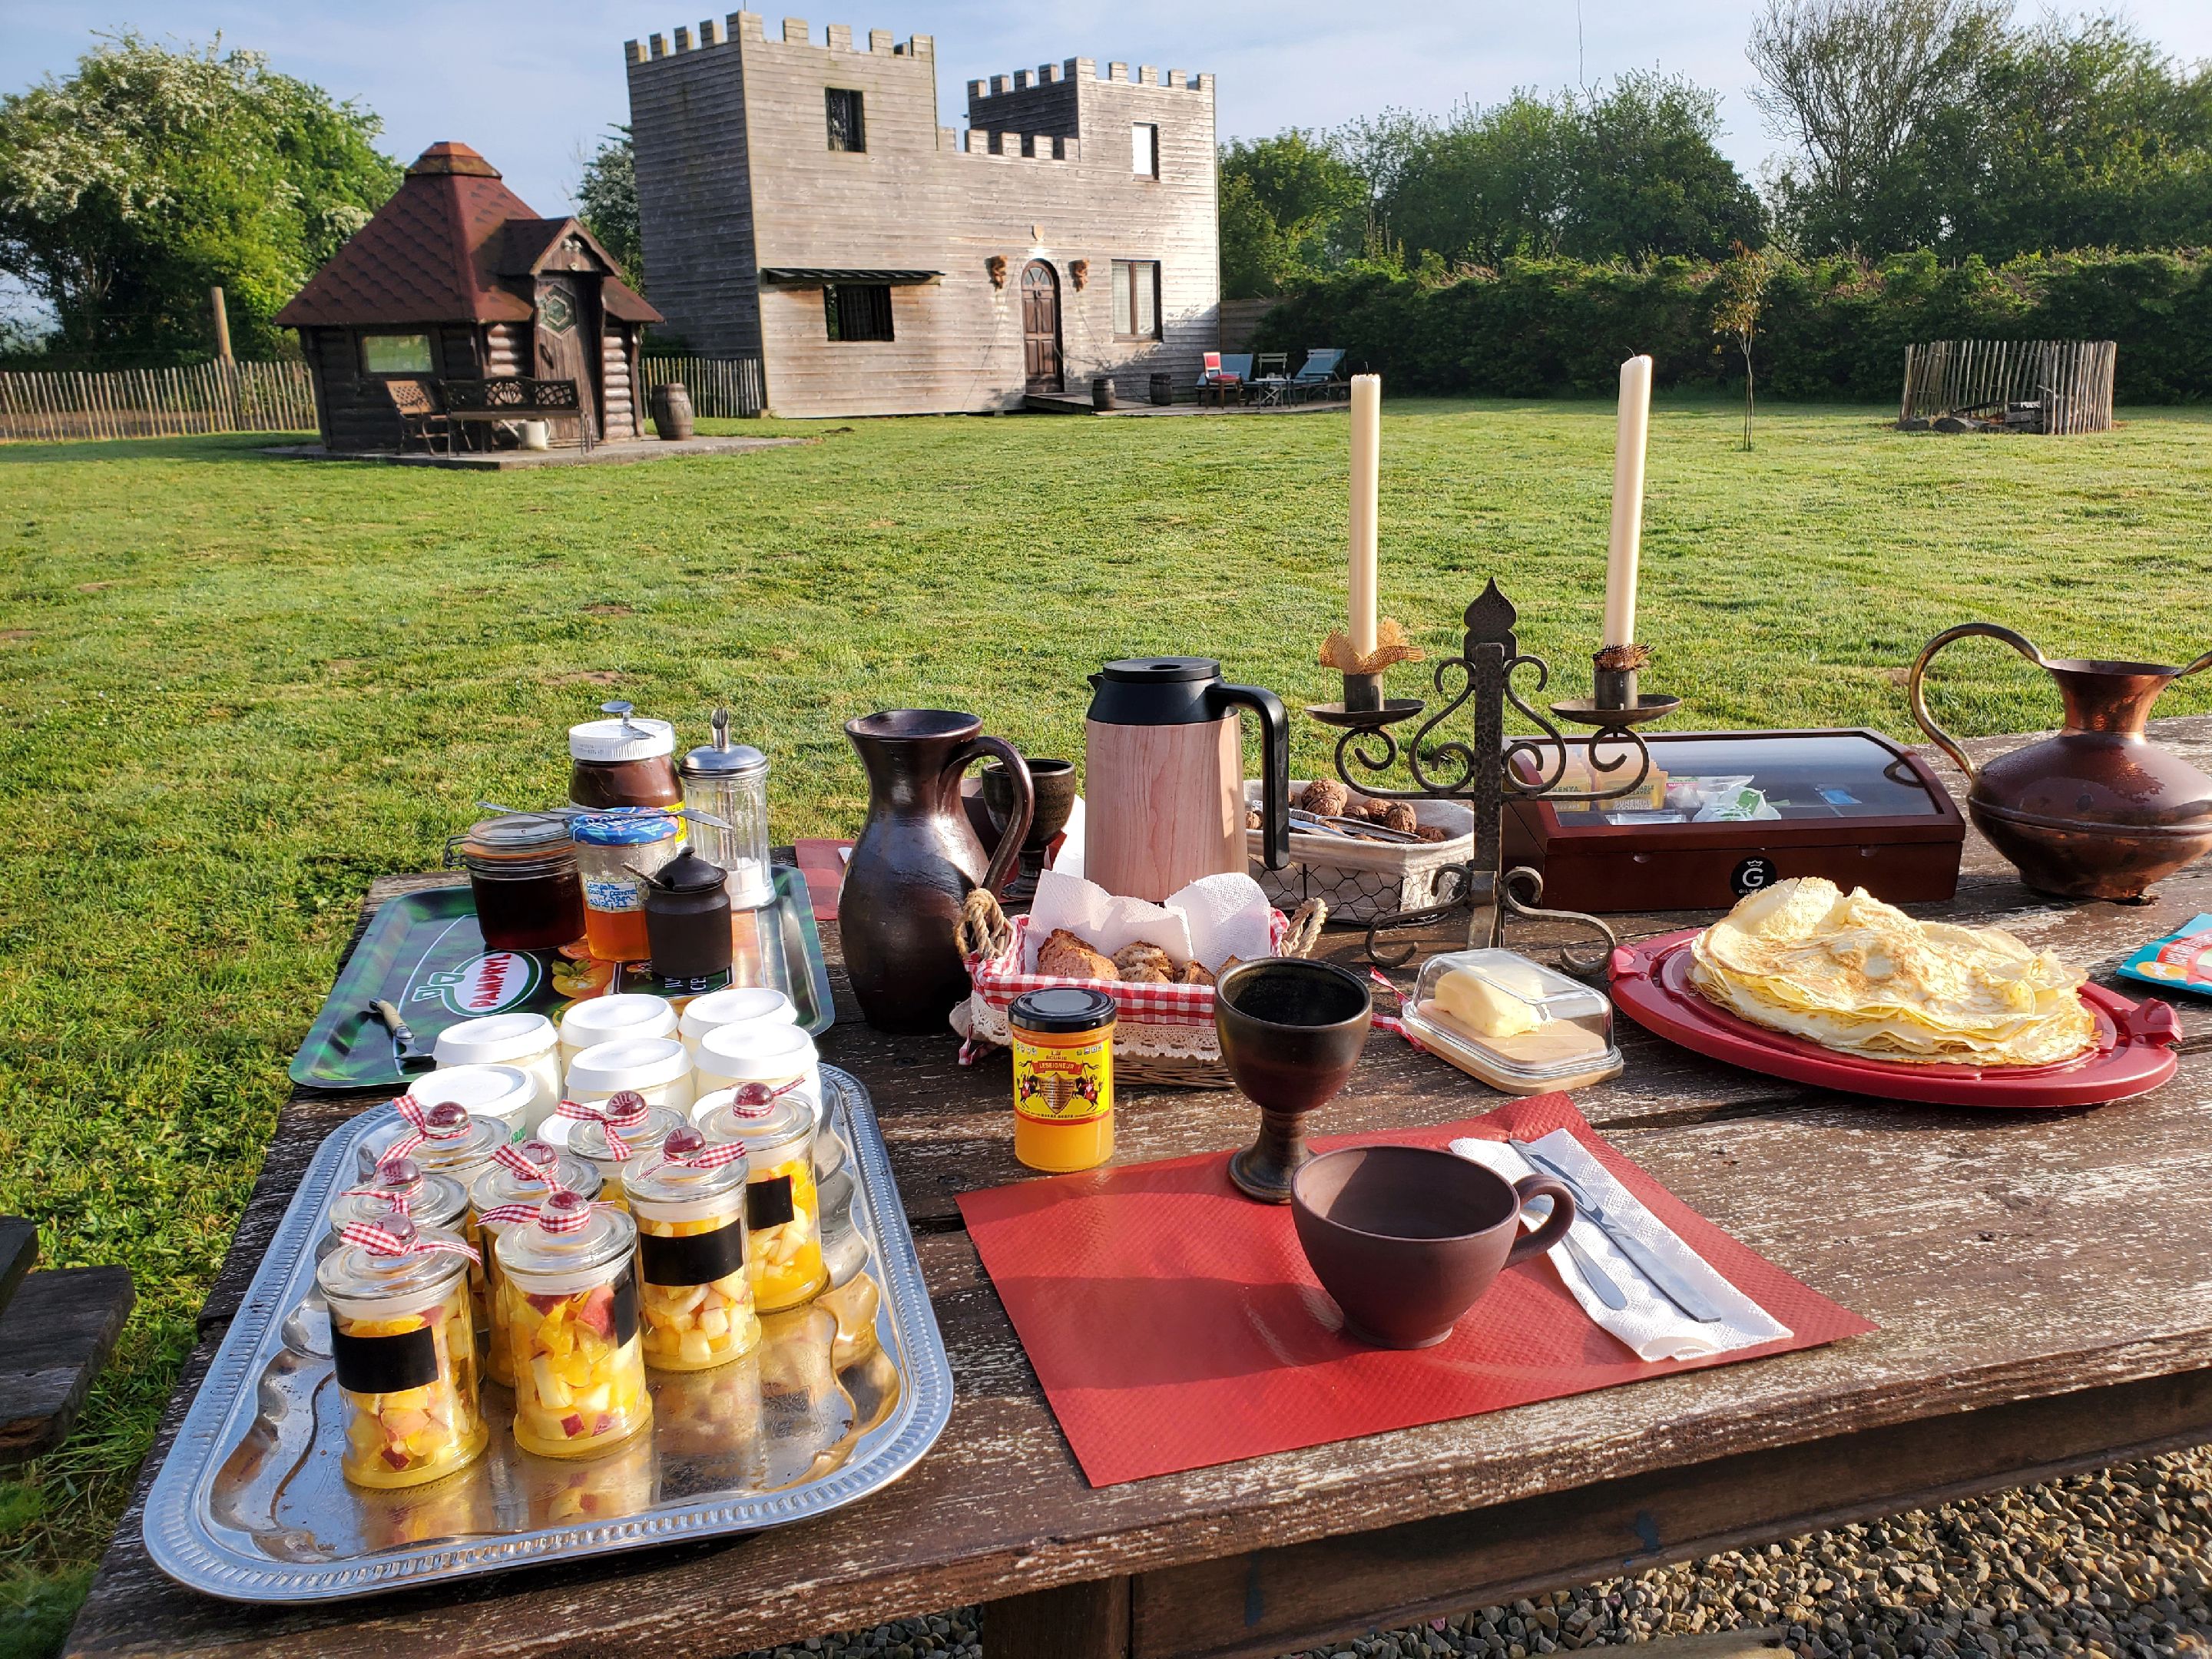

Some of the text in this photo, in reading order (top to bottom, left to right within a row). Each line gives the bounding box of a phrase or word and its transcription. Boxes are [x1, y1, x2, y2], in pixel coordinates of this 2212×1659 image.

[1742, 867, 1764, 886] G
[469, 954, 512, 1008] PAMPRYL
[1039, 1061, 1075, 1070] LESEIGNEUR
